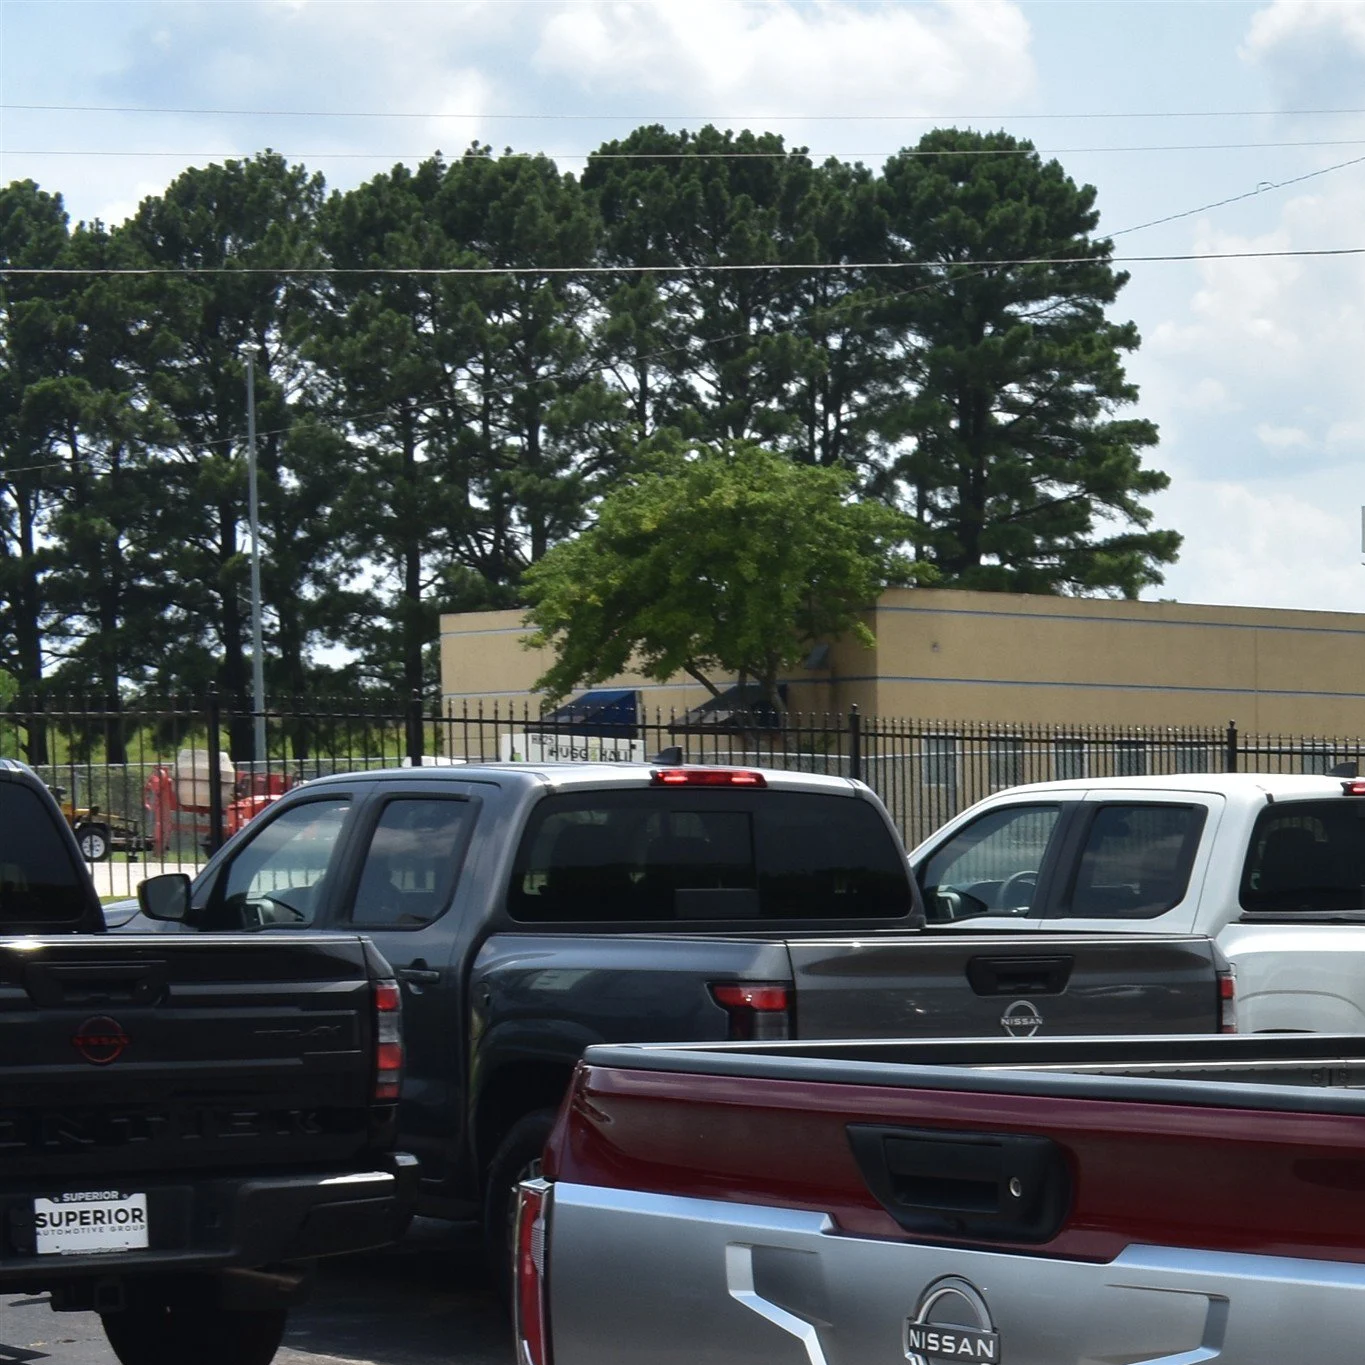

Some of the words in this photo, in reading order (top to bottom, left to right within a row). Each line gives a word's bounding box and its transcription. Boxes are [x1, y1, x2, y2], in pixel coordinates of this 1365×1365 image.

[1001, 1018, 1043, 1026] NISSAN
[62, 1190, 119, 1202] SUPERIOR
[35, 1207, 145, 1229] SUPERIOR
[36, 1226, 104, 1236] AUTOMOTIVE
[110, 1225, 146, 1233] GROUP
[908, 1327, 997, 1359] NISSAN
